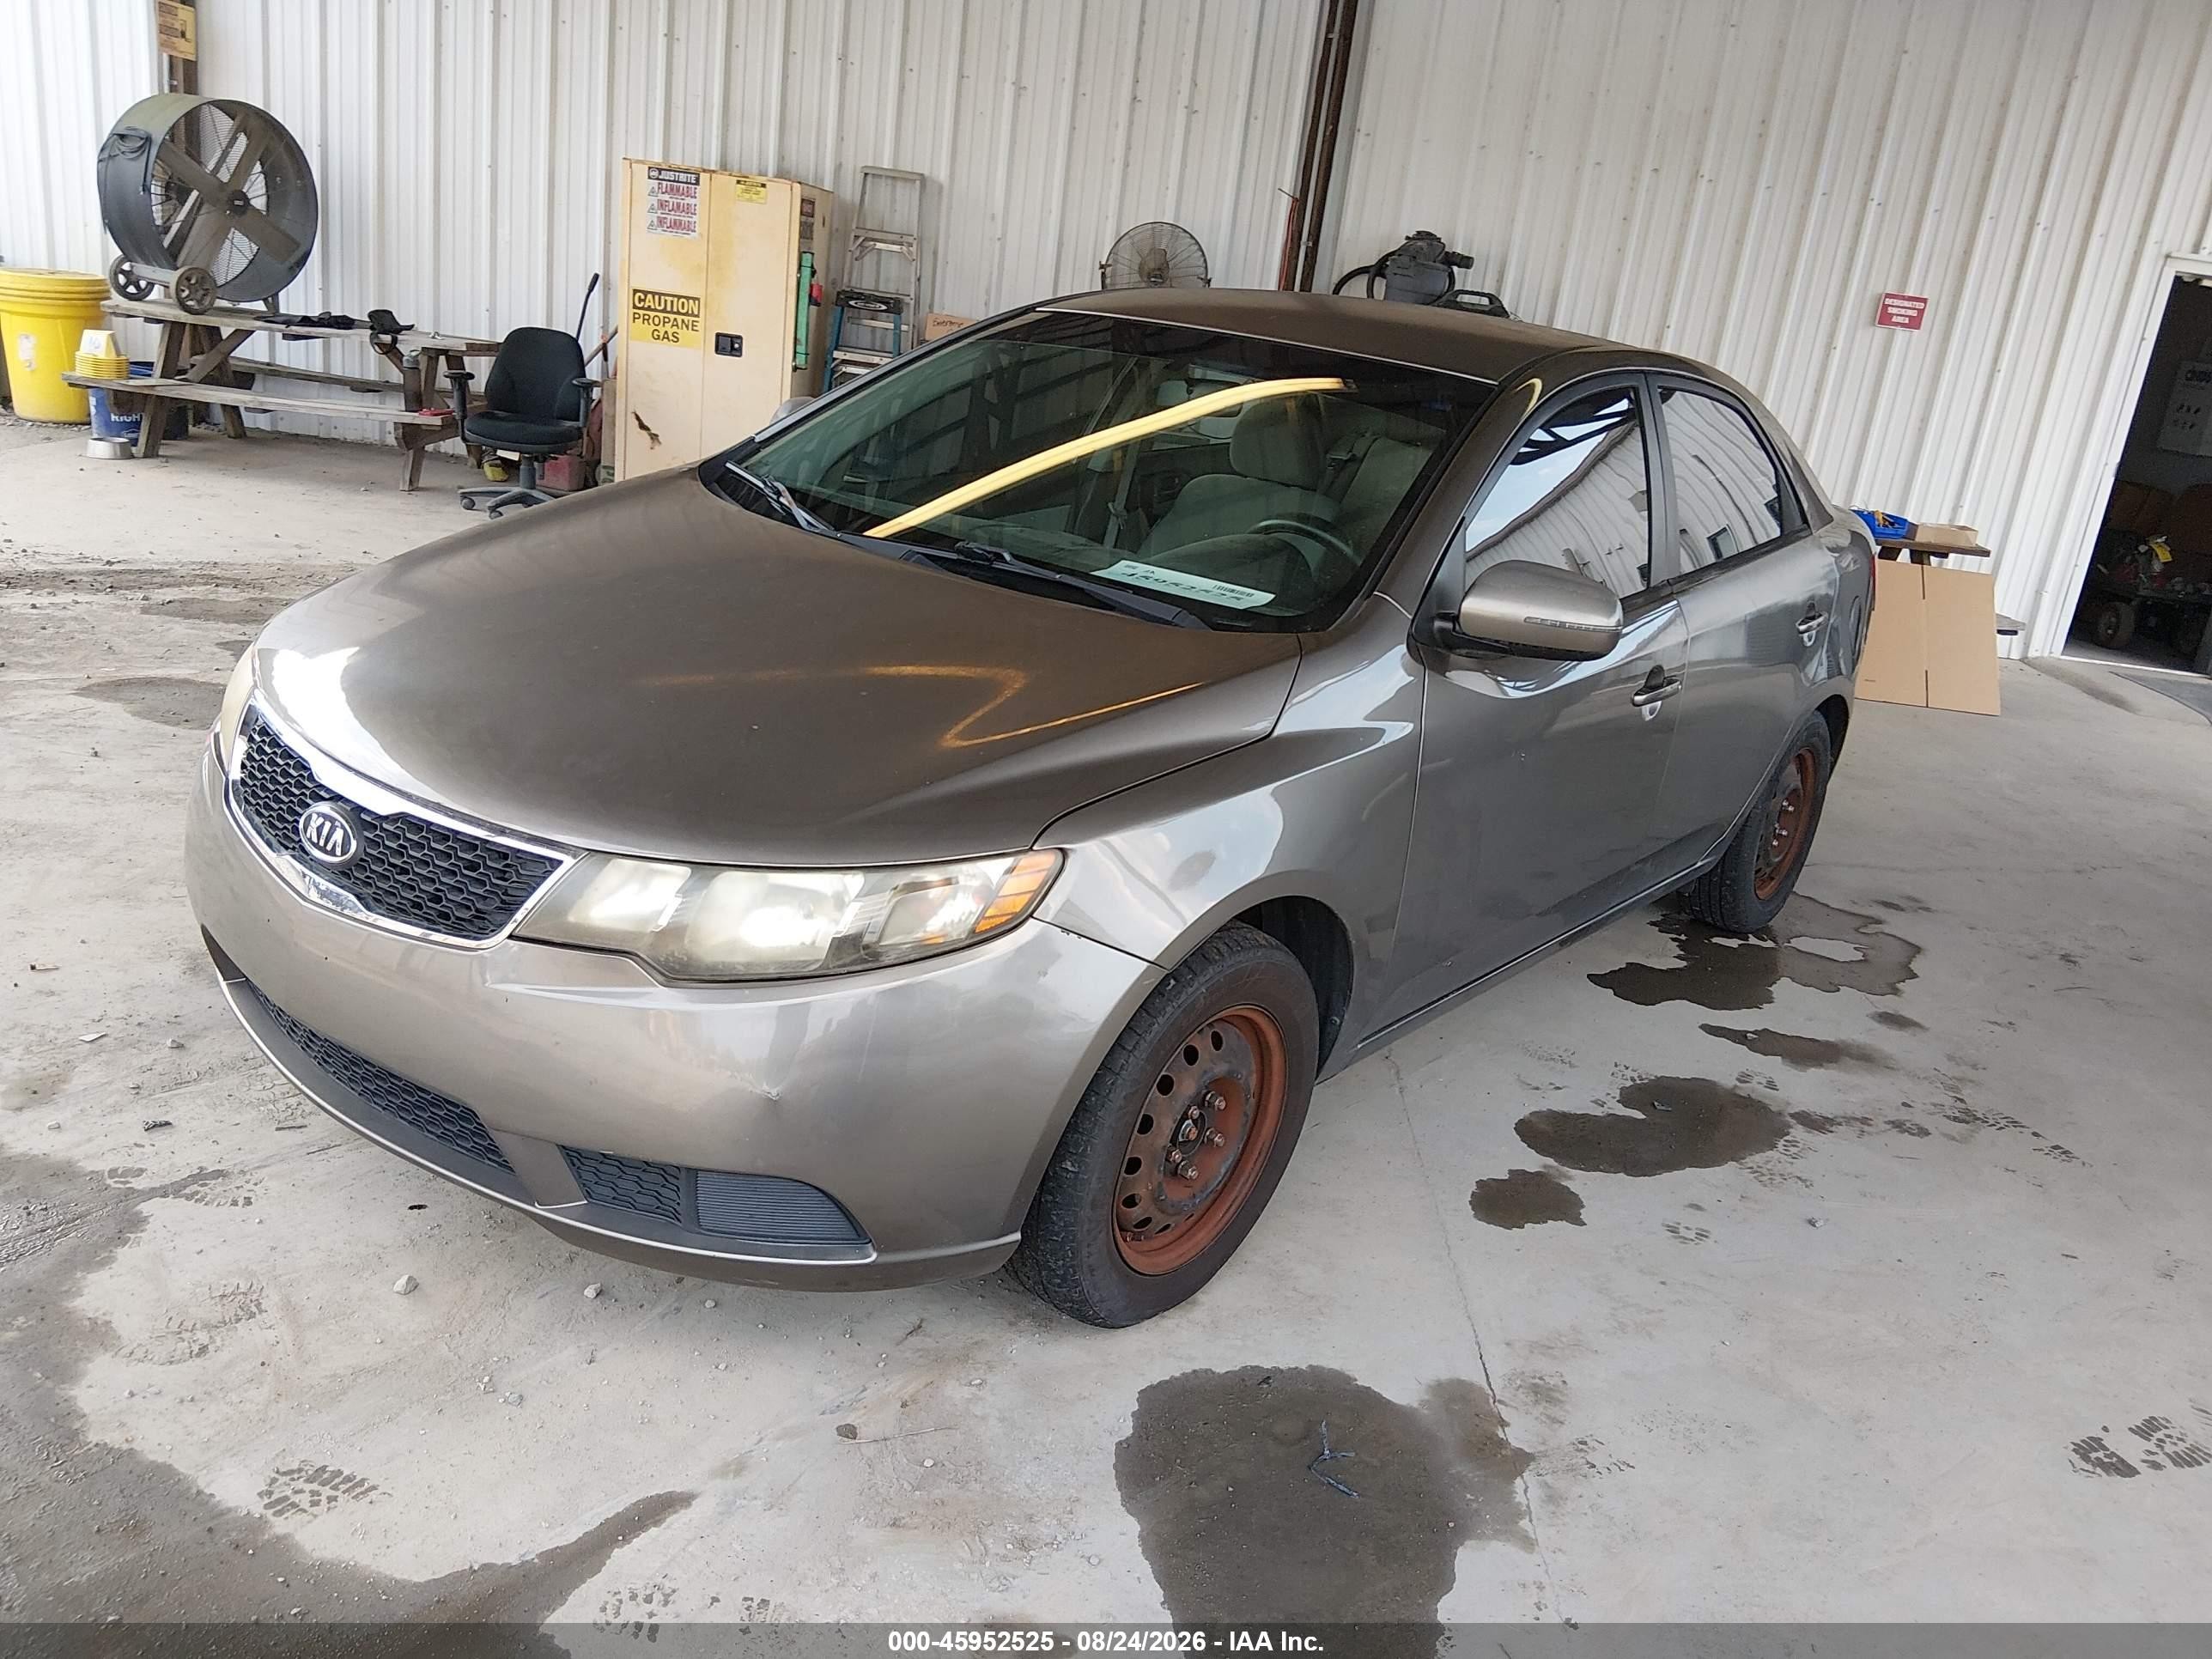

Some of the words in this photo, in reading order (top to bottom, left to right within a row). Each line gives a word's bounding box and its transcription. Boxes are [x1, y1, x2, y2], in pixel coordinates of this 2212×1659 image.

[659, 170, 696, 184] JUSTRITE
[658, 181, 697, 199] FLAMMABLE
[657, 198, 697, 216] INFLAMABLE
[634, 292, 699, 315] CAUTION
[632, 312, 700, 332] PROPANE
[651, 328, 680, 343] GAS
[306, 812, 344, 856] KIA
